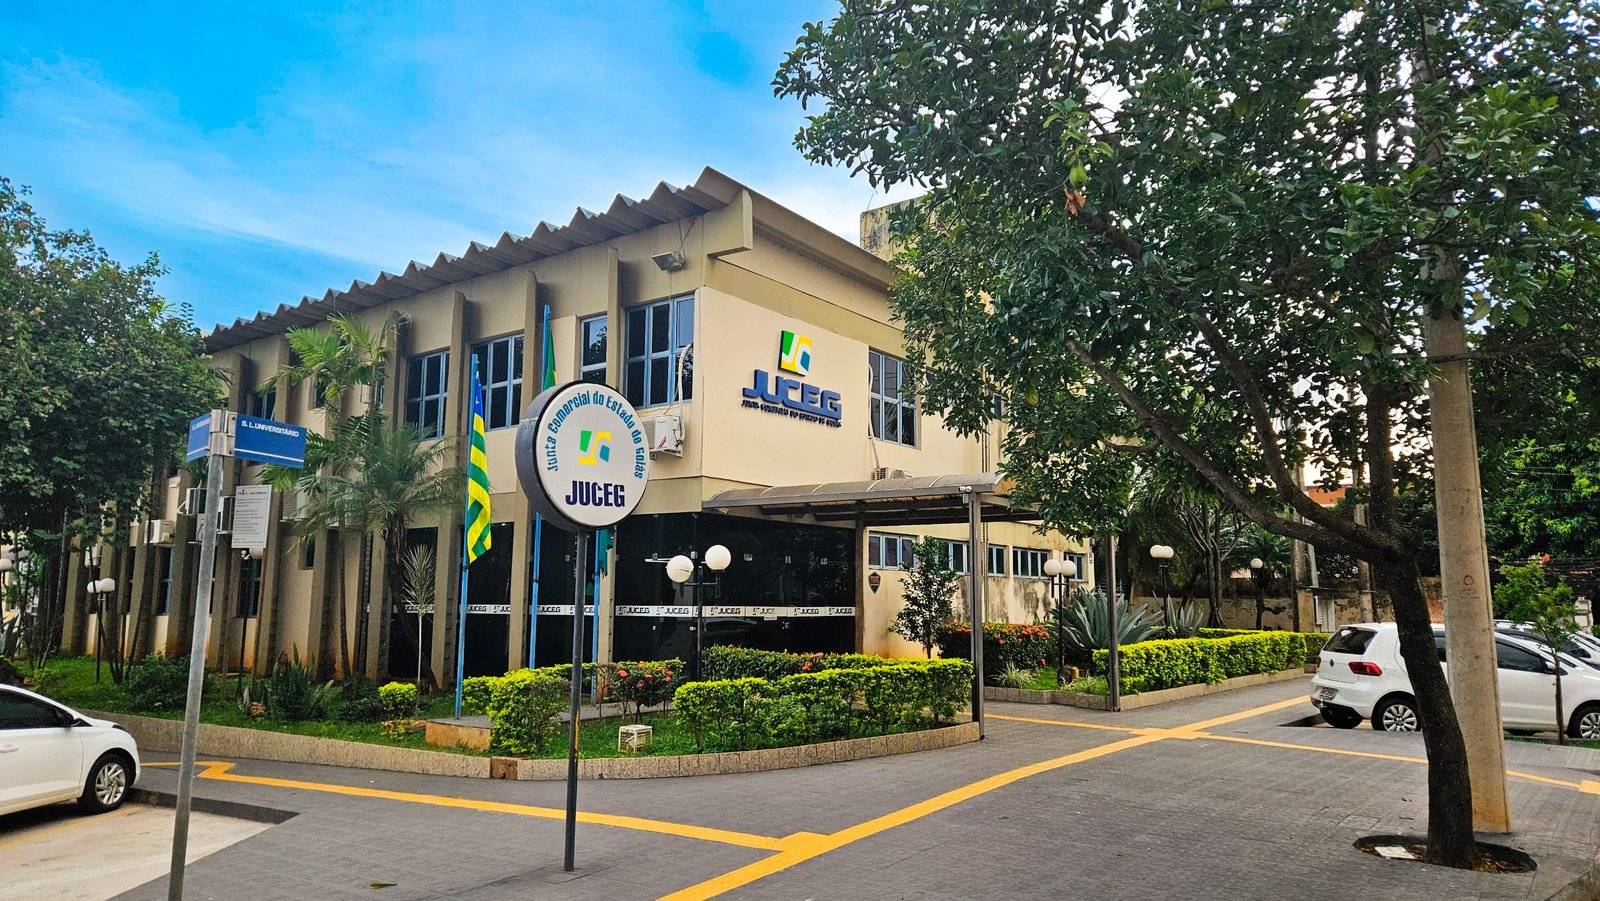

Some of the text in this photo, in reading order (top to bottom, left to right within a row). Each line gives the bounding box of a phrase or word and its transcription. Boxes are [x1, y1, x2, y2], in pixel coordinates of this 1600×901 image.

[742, 369, 842, 420] JUCEG
[545, 390, 646, 479] Junta Comercial do Estado de Goiás
[565, 480, 625, 507] JUCEG
[665, 607, 689, 615] JUCEG
[718, 607, 741, 615] JUCEG
